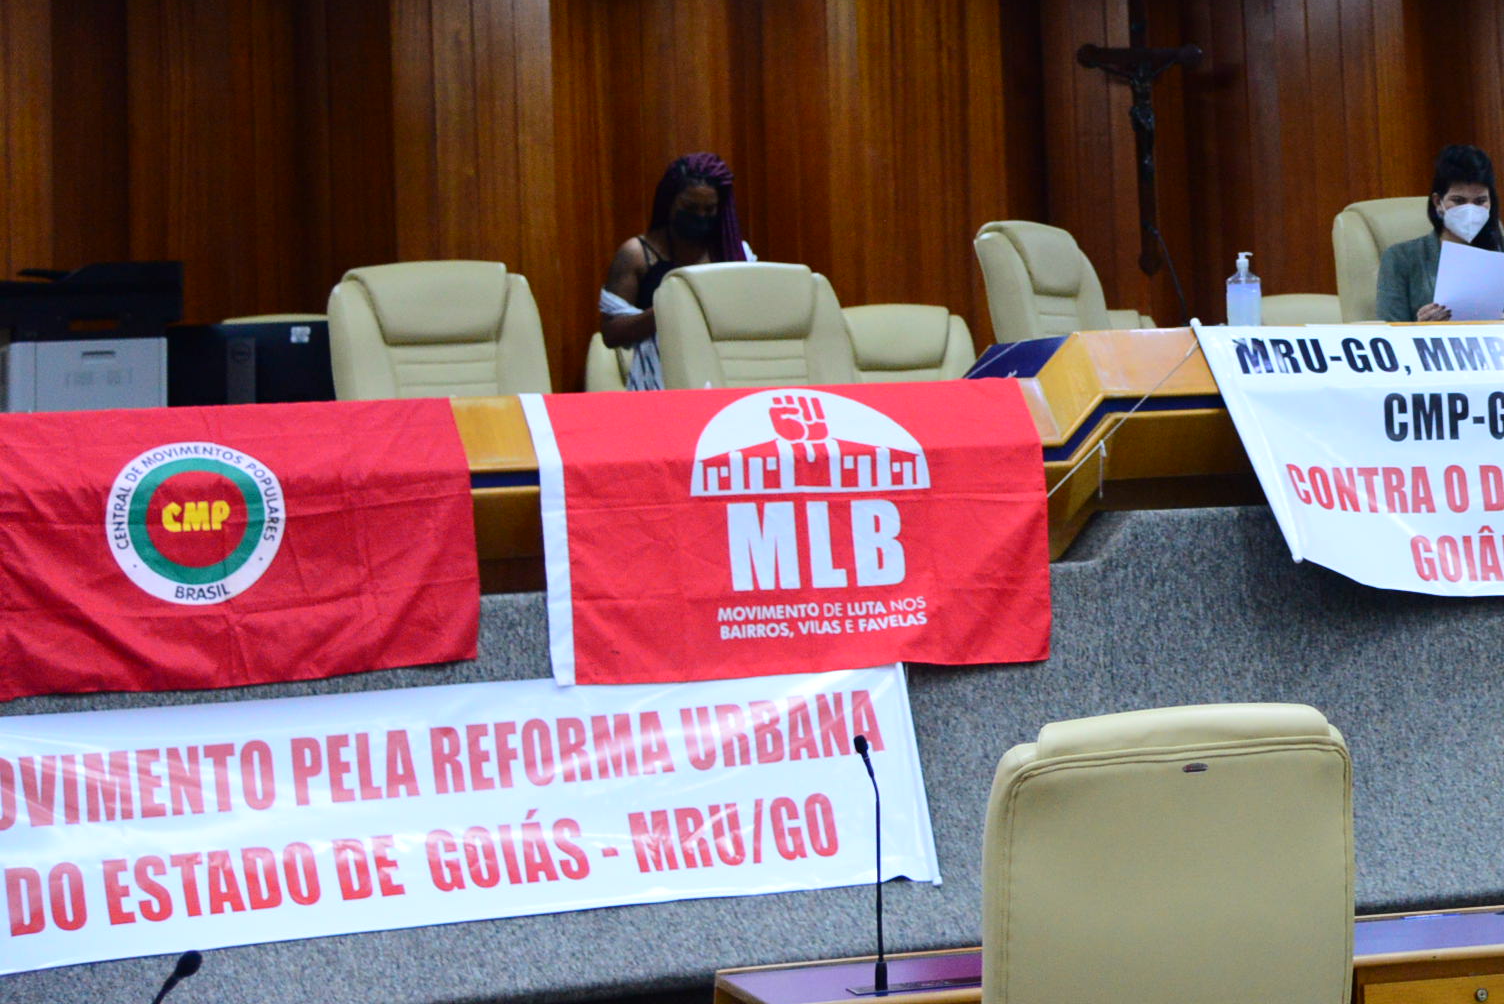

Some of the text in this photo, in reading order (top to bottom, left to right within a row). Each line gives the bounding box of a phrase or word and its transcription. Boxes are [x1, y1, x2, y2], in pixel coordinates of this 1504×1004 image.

[1232, 337, 1411, 375] MRU-GO,
[113, 445, 279, 550] CENTRAL DE MOVIMENTOS POPULARES
[1286, 463, 1436, 514] CONTRA
[1443, 464, 1471, 513] O
[162, 500, 230, 532] CMP
[726, 499, 905, 592] MLB
[174, 583, 231, 601] BRASIL
[717, 596, 926, 622] MOVIMENTO DE LUTA NOS
[720, 611, 928, 640] BAIRROS, VILAS E FAVELAS
[291, 729, 421, 807] PELA
[430, 710, 675, 795] REFORMA
[680, 690, 885, 771] URBANA
[4, 862, 87, 937] DO
[103, 841, 322, 926] ESTADO
[331, 834, 406, 901] DE
[425, 809, 590, 892] GOIÁS
[627, 792, 839, 873] MRU/GO
